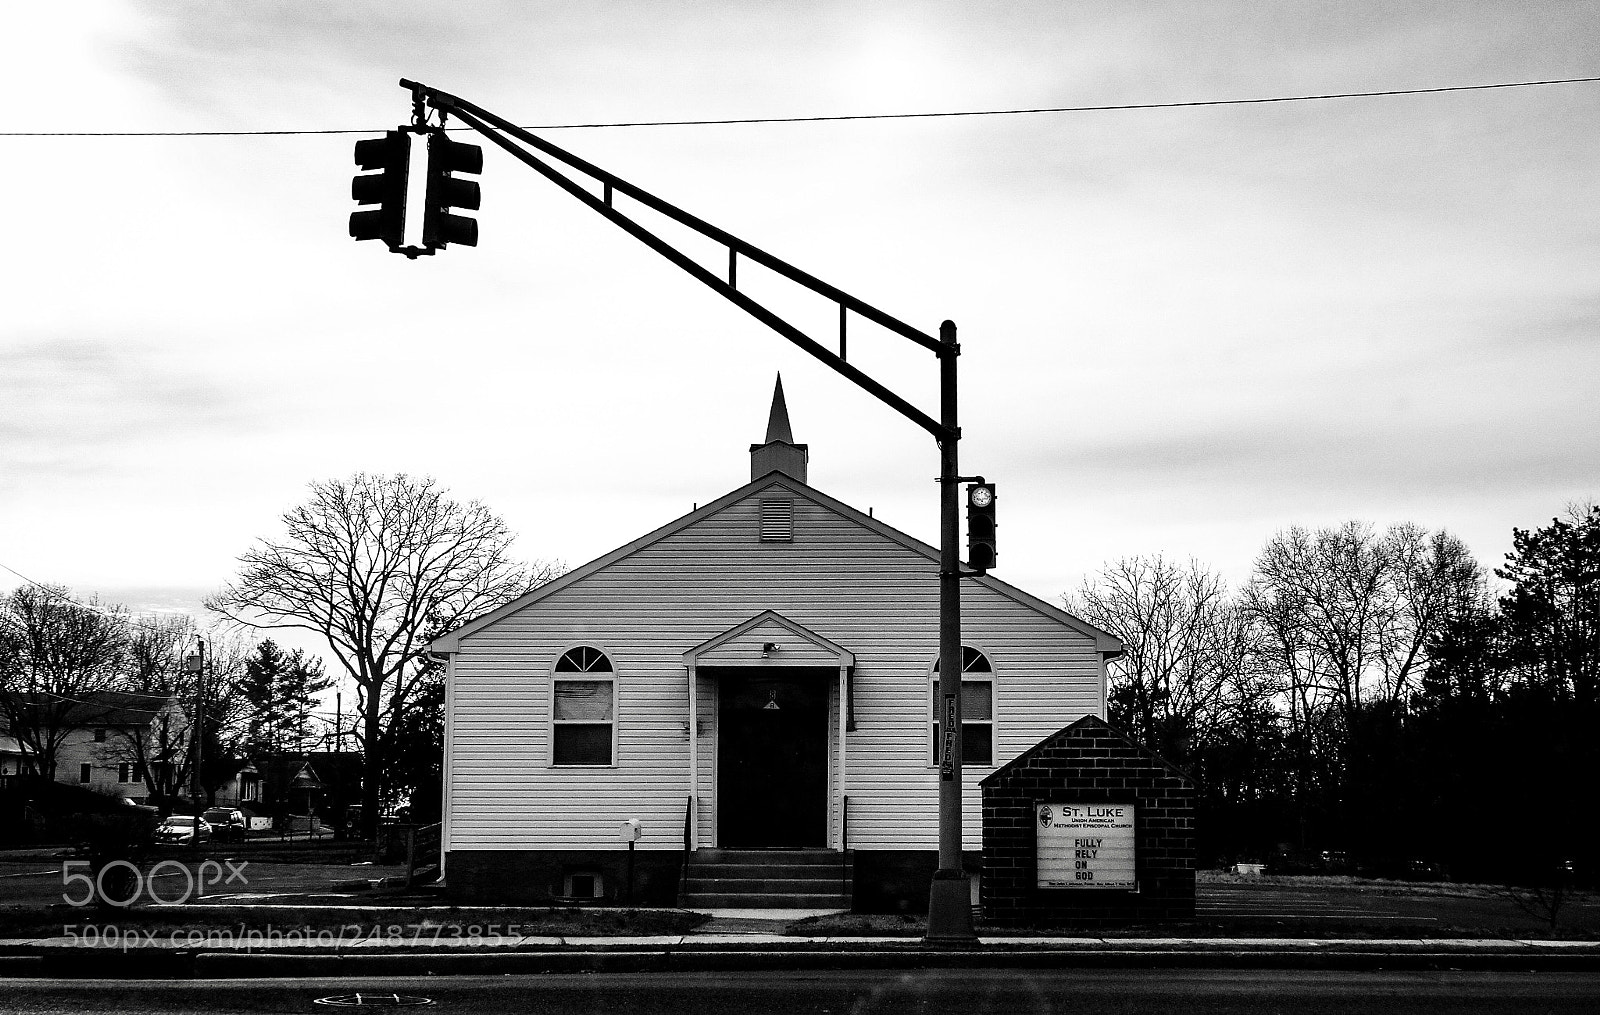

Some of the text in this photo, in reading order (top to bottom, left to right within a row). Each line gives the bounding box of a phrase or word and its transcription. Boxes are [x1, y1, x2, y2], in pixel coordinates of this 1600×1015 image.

[1062, 806, 1124, 817] ST. LUKE
[1074, 839, 1102, 848] FULLY
[1075, 850, 1098, 859] RELY
[1075, 861, 1088, 870] ON
[1075, 871, 1093, 880] GOD
